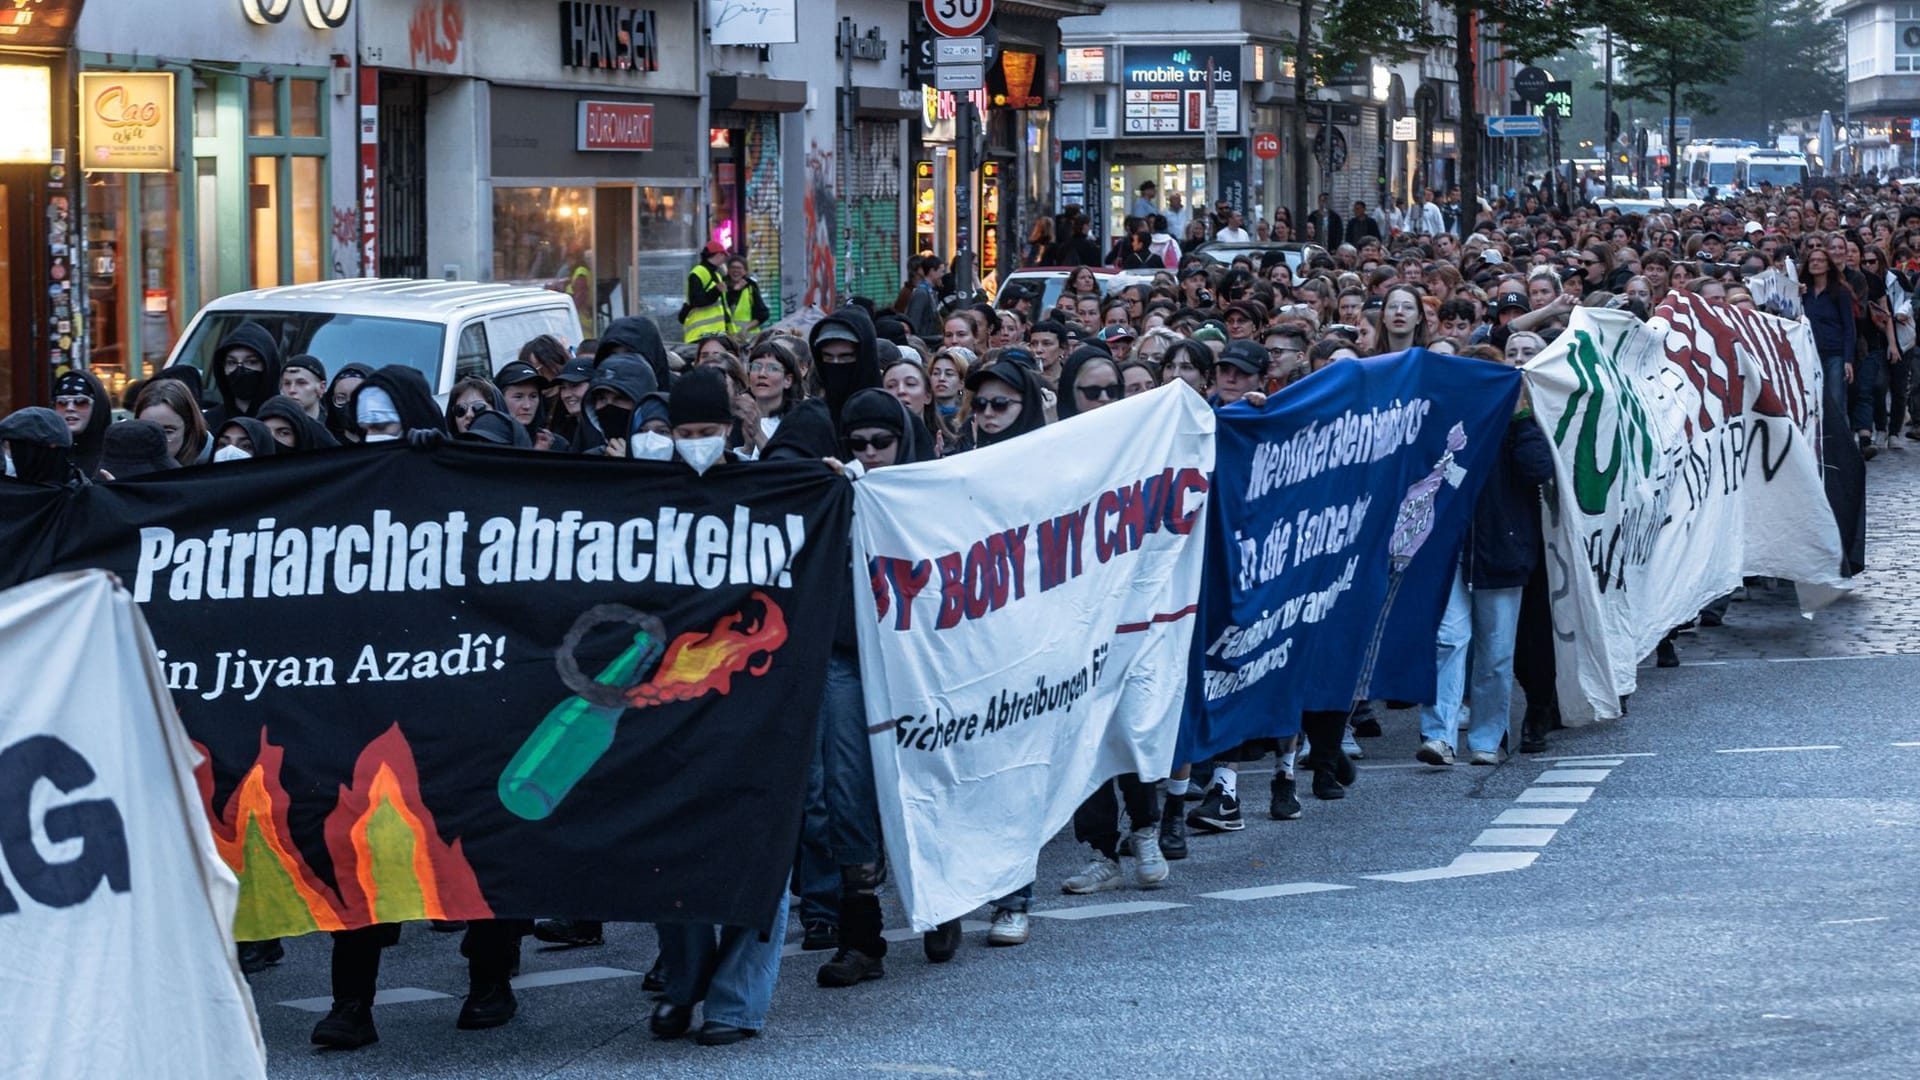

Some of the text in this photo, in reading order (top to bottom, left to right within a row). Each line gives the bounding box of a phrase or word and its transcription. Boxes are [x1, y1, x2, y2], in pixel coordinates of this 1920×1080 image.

[562, 0, 659, 72] HANSEN
[1132, 66, 1184, 82] mobile
[1545, 92, 1571, 105] 24h
[95, 85, 160, 128] Cao
[588, 106, 651, 143] BÜROMARKT
[1256, 137, 1278, 150] ria
[133, 504, 806, 602] Patriarchat abfackeln!
[933, 523, 1030, 632] BODY
[1036, 502, 1092, 593] MY
[201, 648, 336, 701] Jiyan
[346, 632, 507, 685] Azadî!
[894, 707, 979, 752] Sichere
[979, 665, 1089, 738] Abtreibungen
